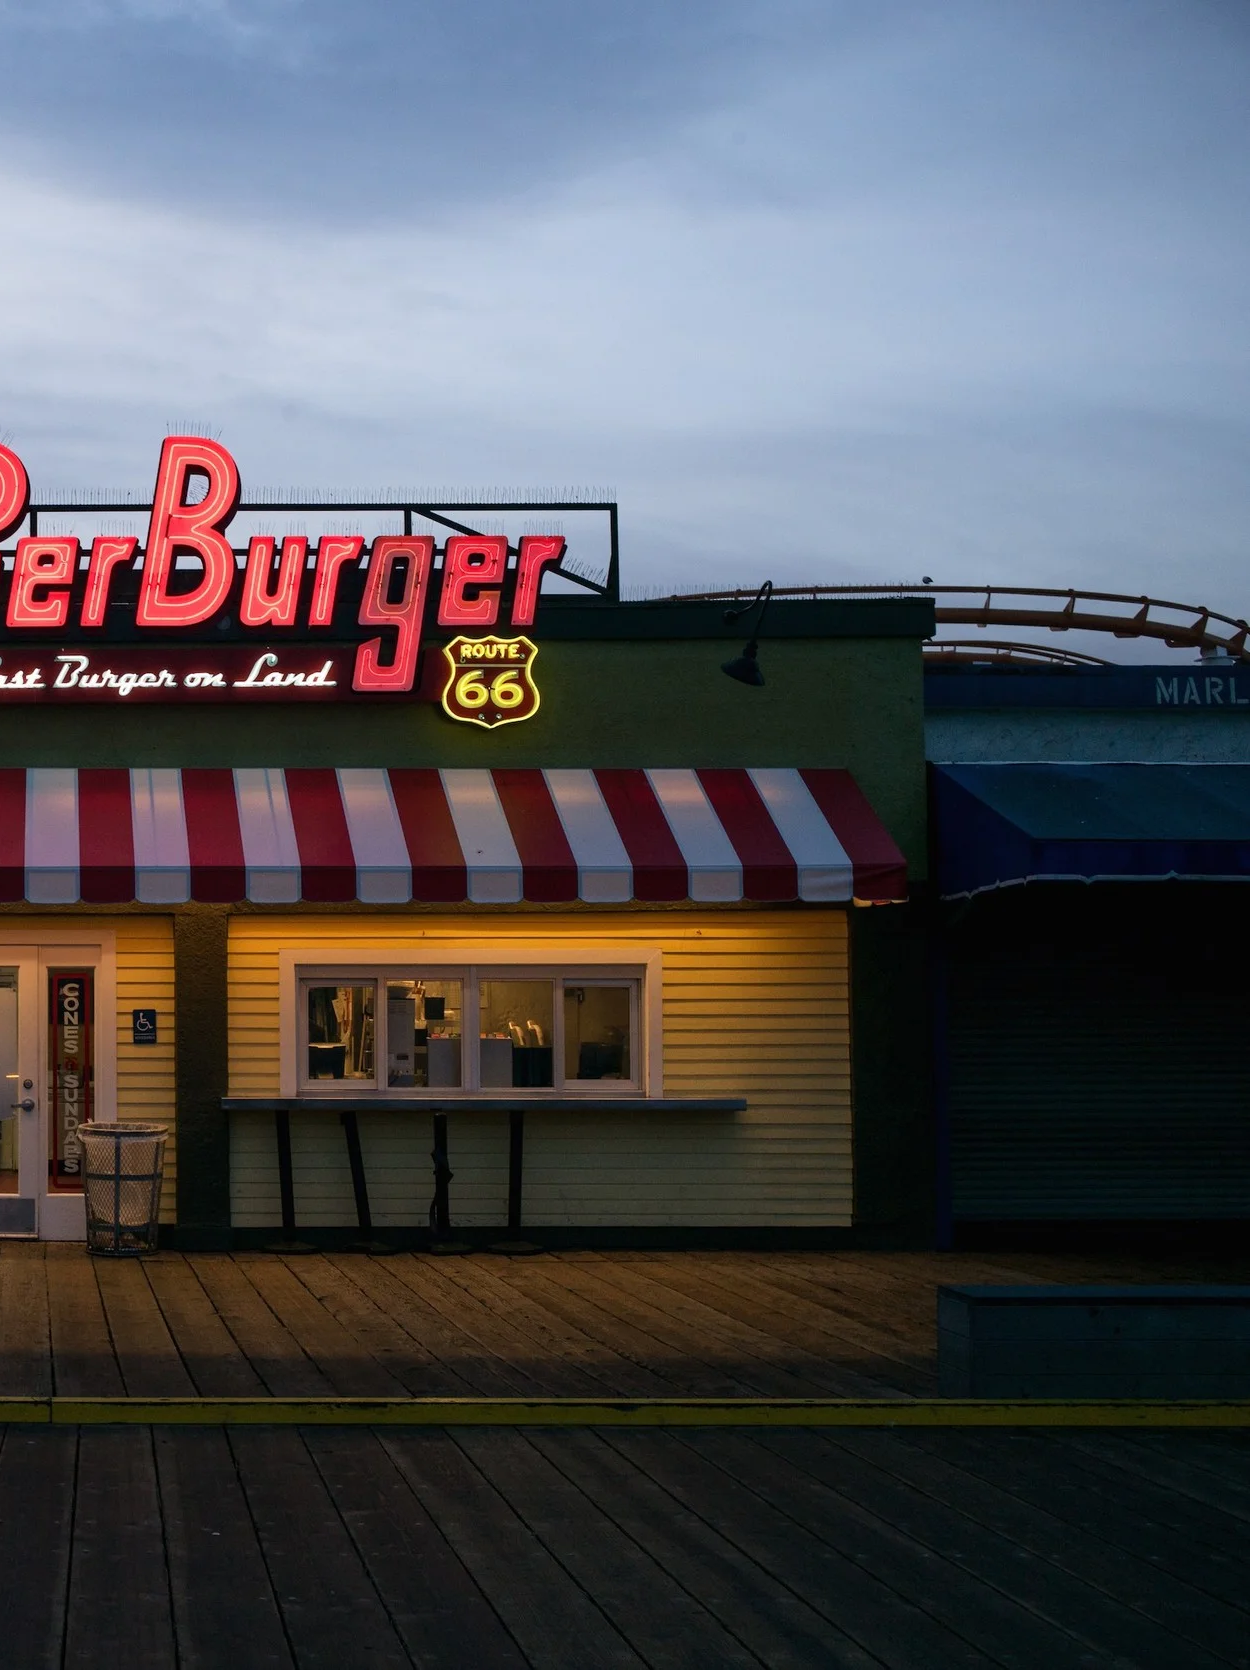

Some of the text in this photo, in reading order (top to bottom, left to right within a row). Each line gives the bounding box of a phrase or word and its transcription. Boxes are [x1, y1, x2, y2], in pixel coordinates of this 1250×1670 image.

[460, 643, 520, 659] ROUTE
[52, 654, 178, 696] Burger
[183, 671, 227, 688] on
[233, 652, 338, 688] Land
[455, 669, 524, 709] 66
[1156, 676, 1250, 705] MARL
[63, 983, 80, 1054] CONES
[63, 1074, 80, 1174] SUNDAES
